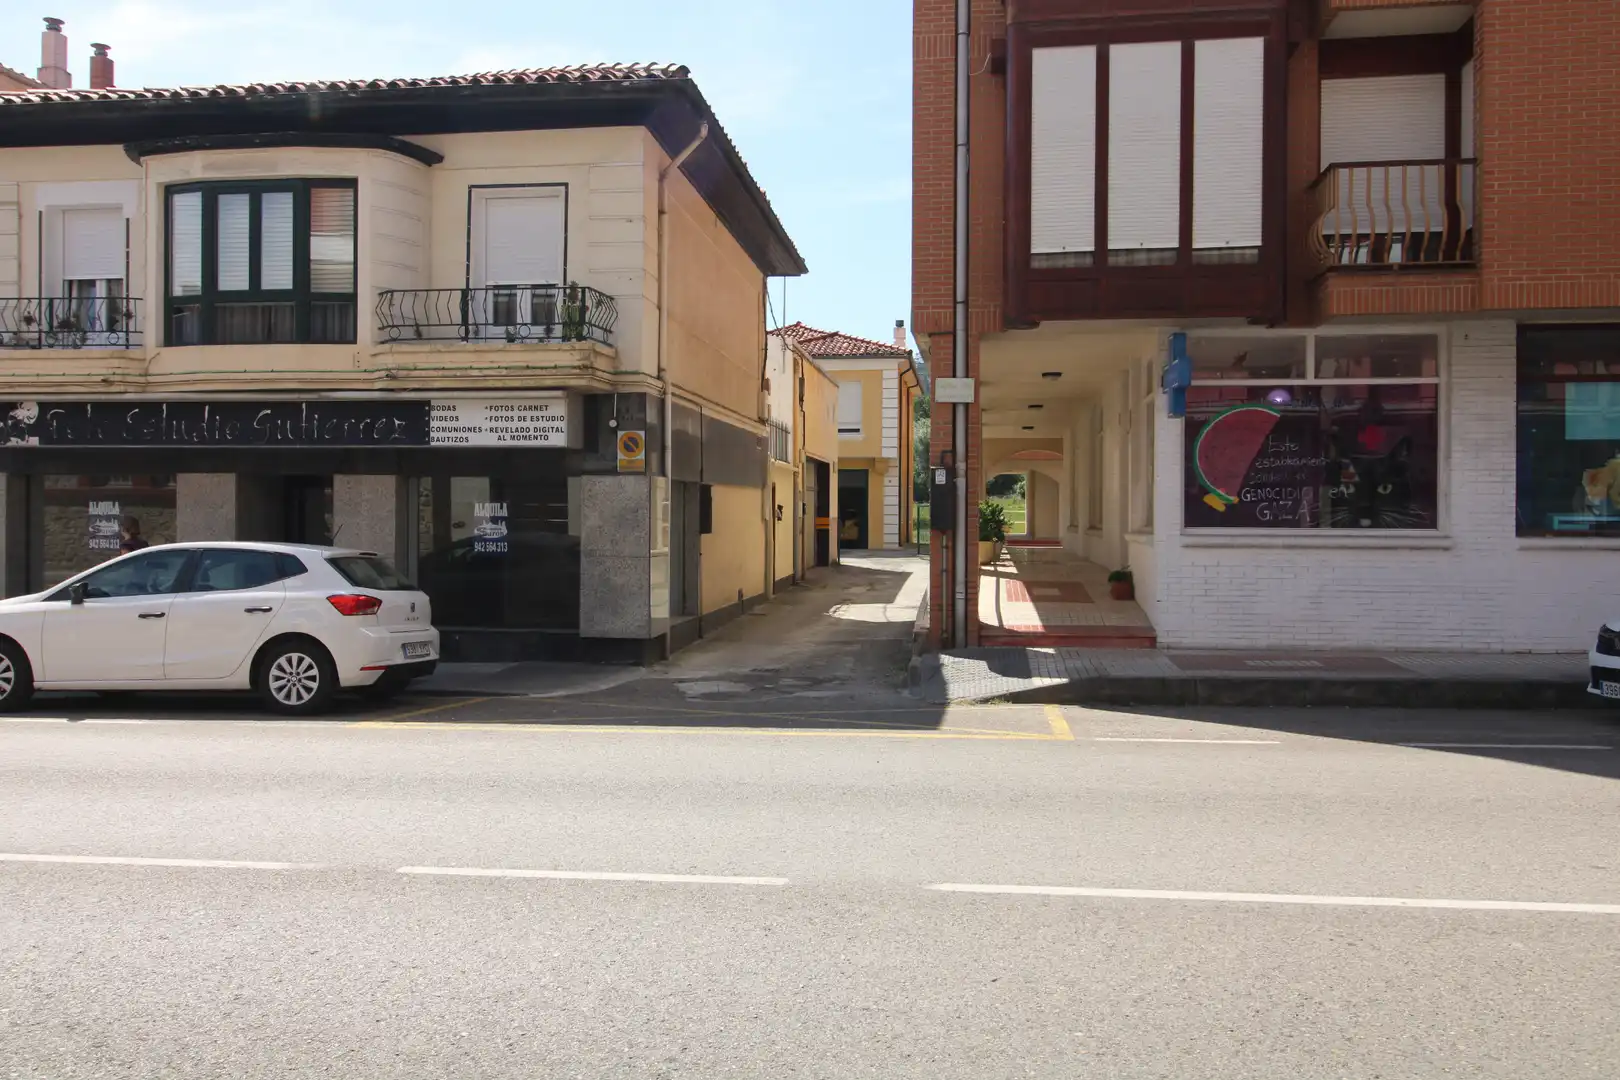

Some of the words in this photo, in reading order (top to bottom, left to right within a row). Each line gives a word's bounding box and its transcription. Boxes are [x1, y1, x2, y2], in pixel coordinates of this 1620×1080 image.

[430, 404, 457, 412] BODAS
[489, 404, 515, 412] FOTOS
[517, 404, 549, 412] CARNET
[252, 402, 407, 443] Gutierrez
[1268, 434, 1299, 453] Este
[1241, 485, 1313, 502] GENOCIDIO
[88, 501, 120, 515] ALQUILA
[474, 502, 508, 517] ALQUILA
[1256, 500, 1310, 521] GAZA
[474, 541, 485, 552] 942
[497, 541, 508, 552] 313
